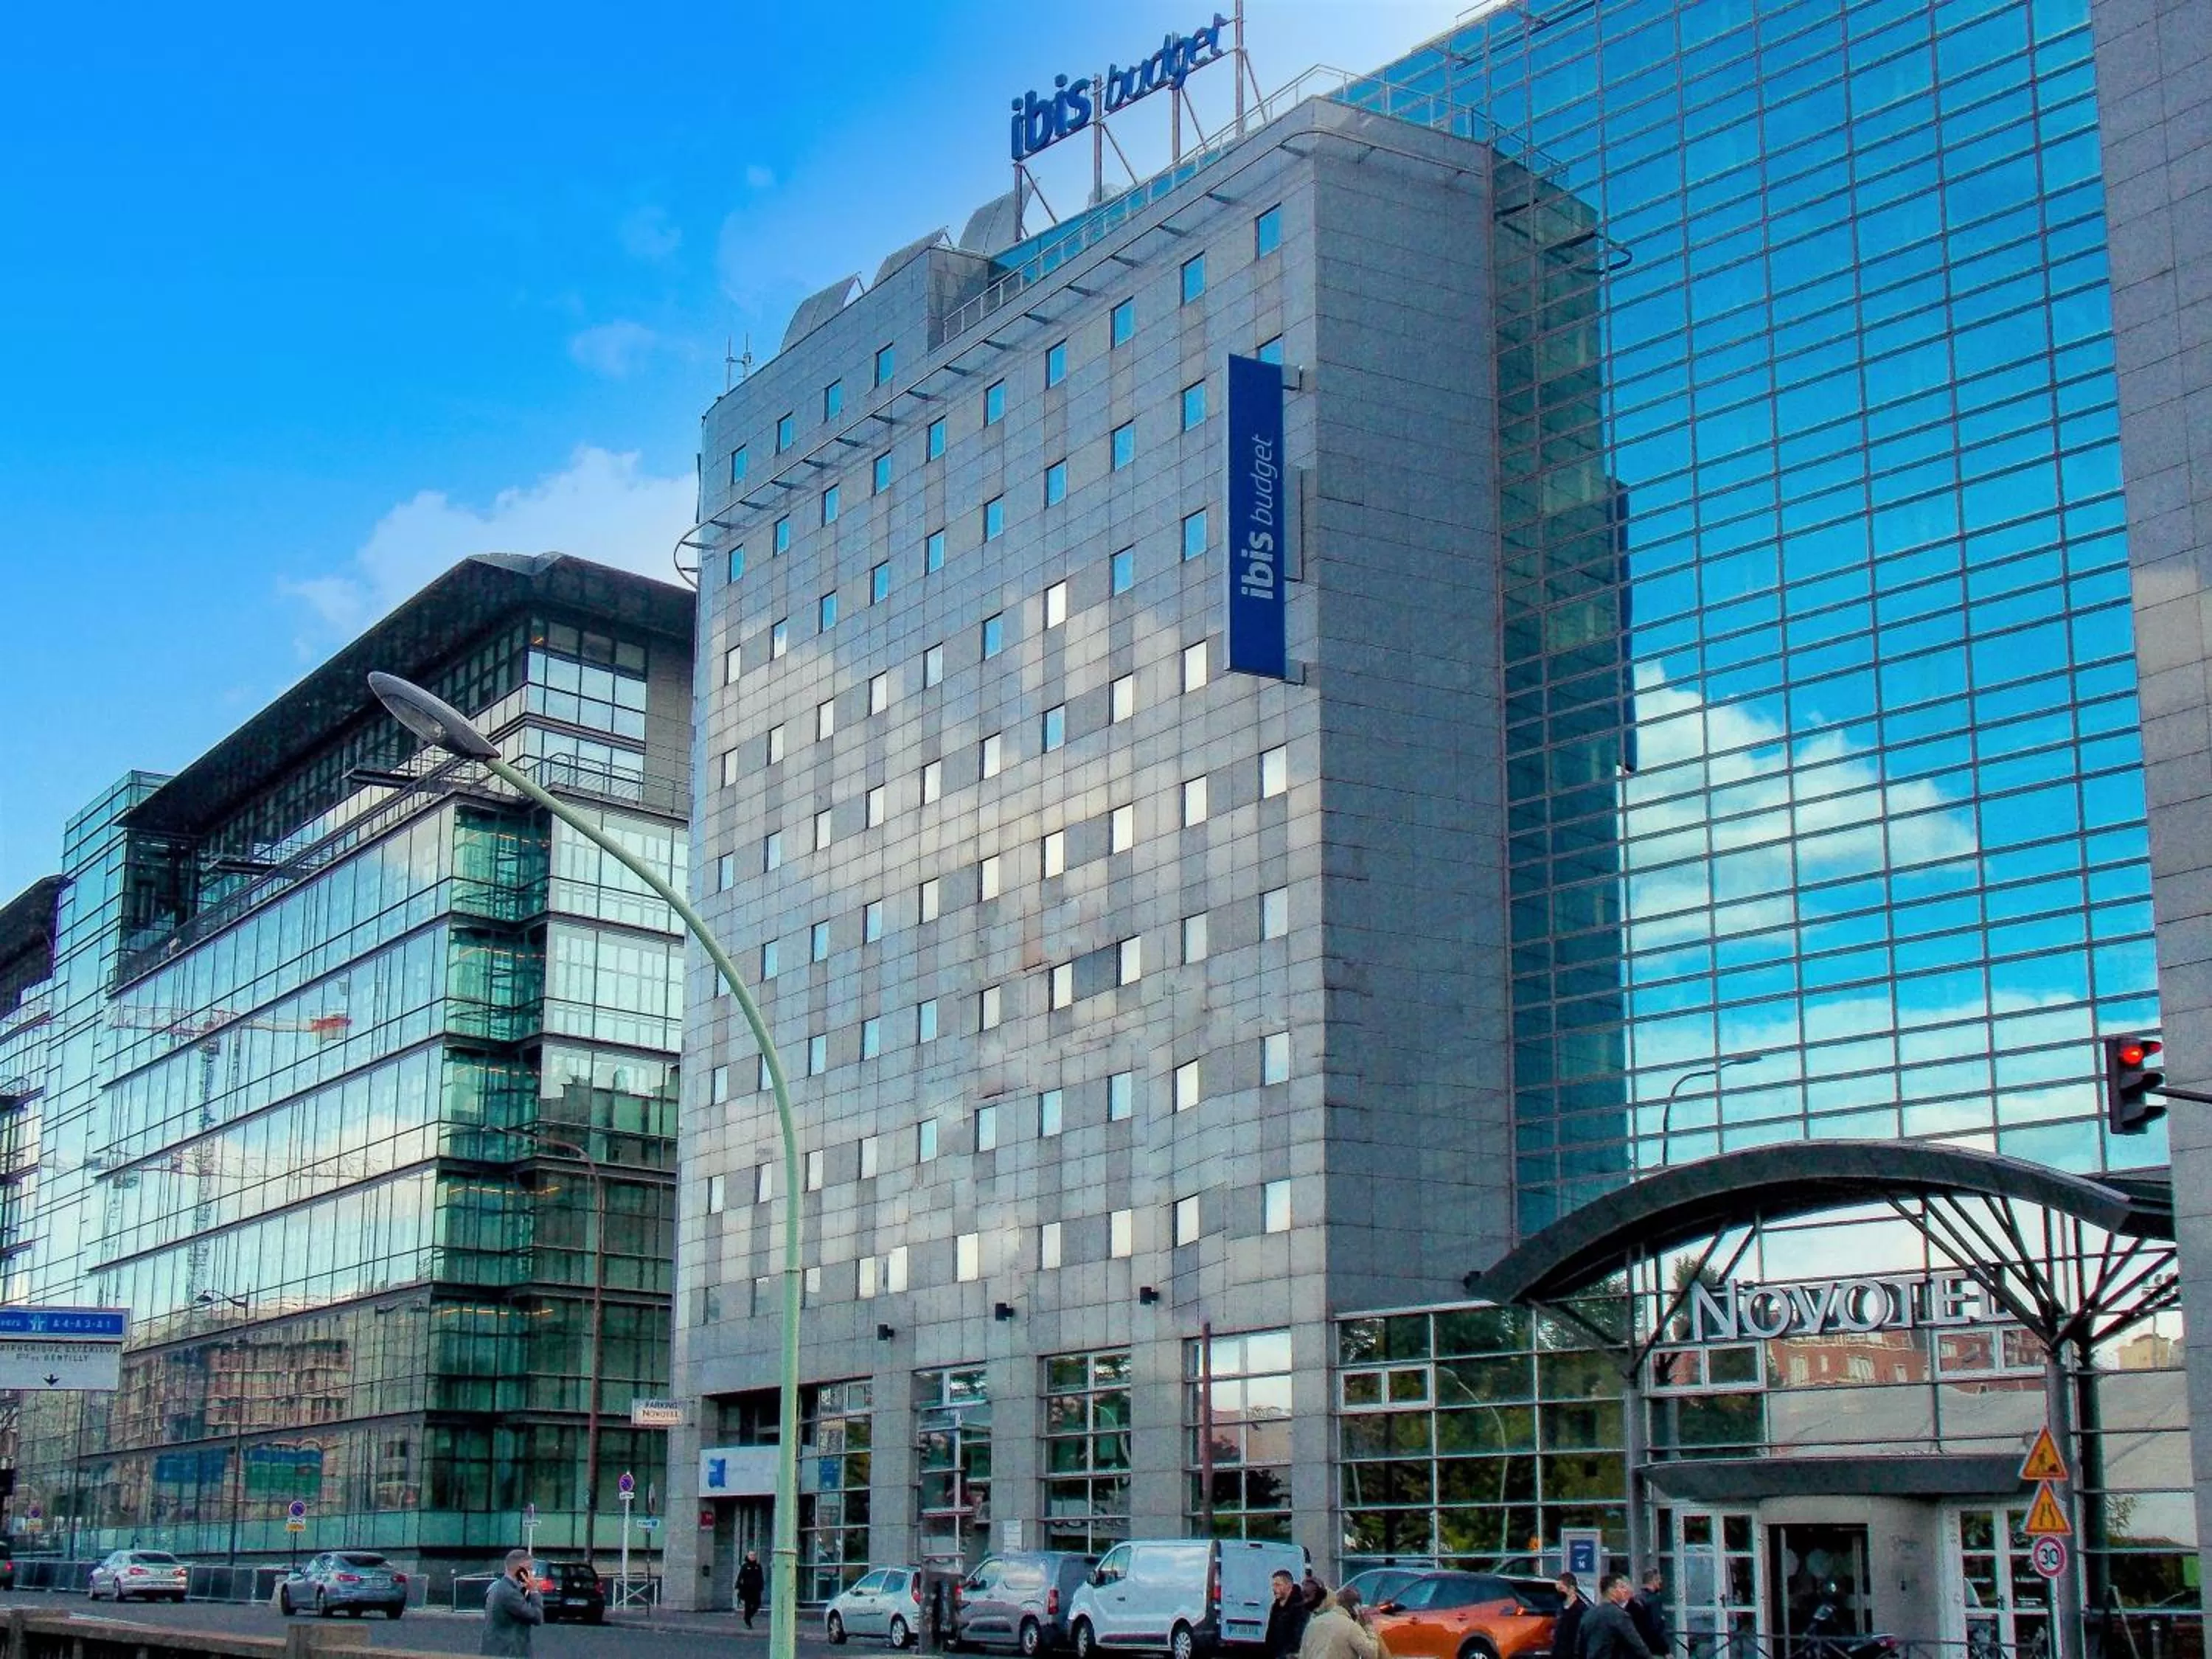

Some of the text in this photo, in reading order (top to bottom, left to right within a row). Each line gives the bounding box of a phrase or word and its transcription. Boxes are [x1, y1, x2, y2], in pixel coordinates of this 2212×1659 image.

[1011, 13, 1228, 160] ibis budget
[1241, 433, 1278, 600] ibis budget
[1691, 1269, 2019, 1342] NOVOTEL
[2039, 1548, 2060, 1565] 30
